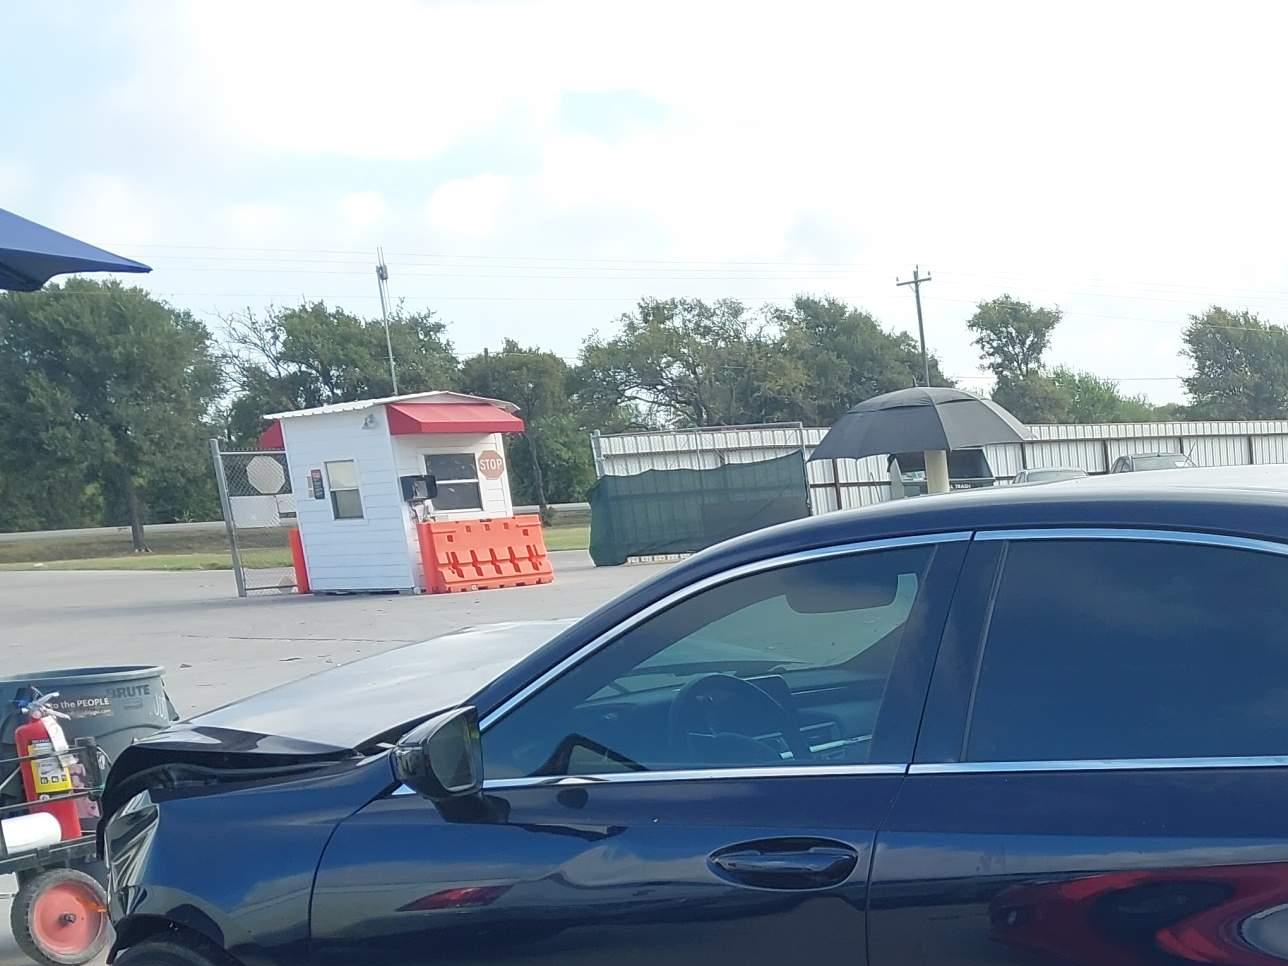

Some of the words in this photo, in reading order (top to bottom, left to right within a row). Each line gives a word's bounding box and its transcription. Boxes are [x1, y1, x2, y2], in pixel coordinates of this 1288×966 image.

[480, 459, 502, 470] STOP
[106, 684, 151, 698] BRUTE
[60, 700, 76, 709] the
[76, 697, 110, 707] PEOPLE
